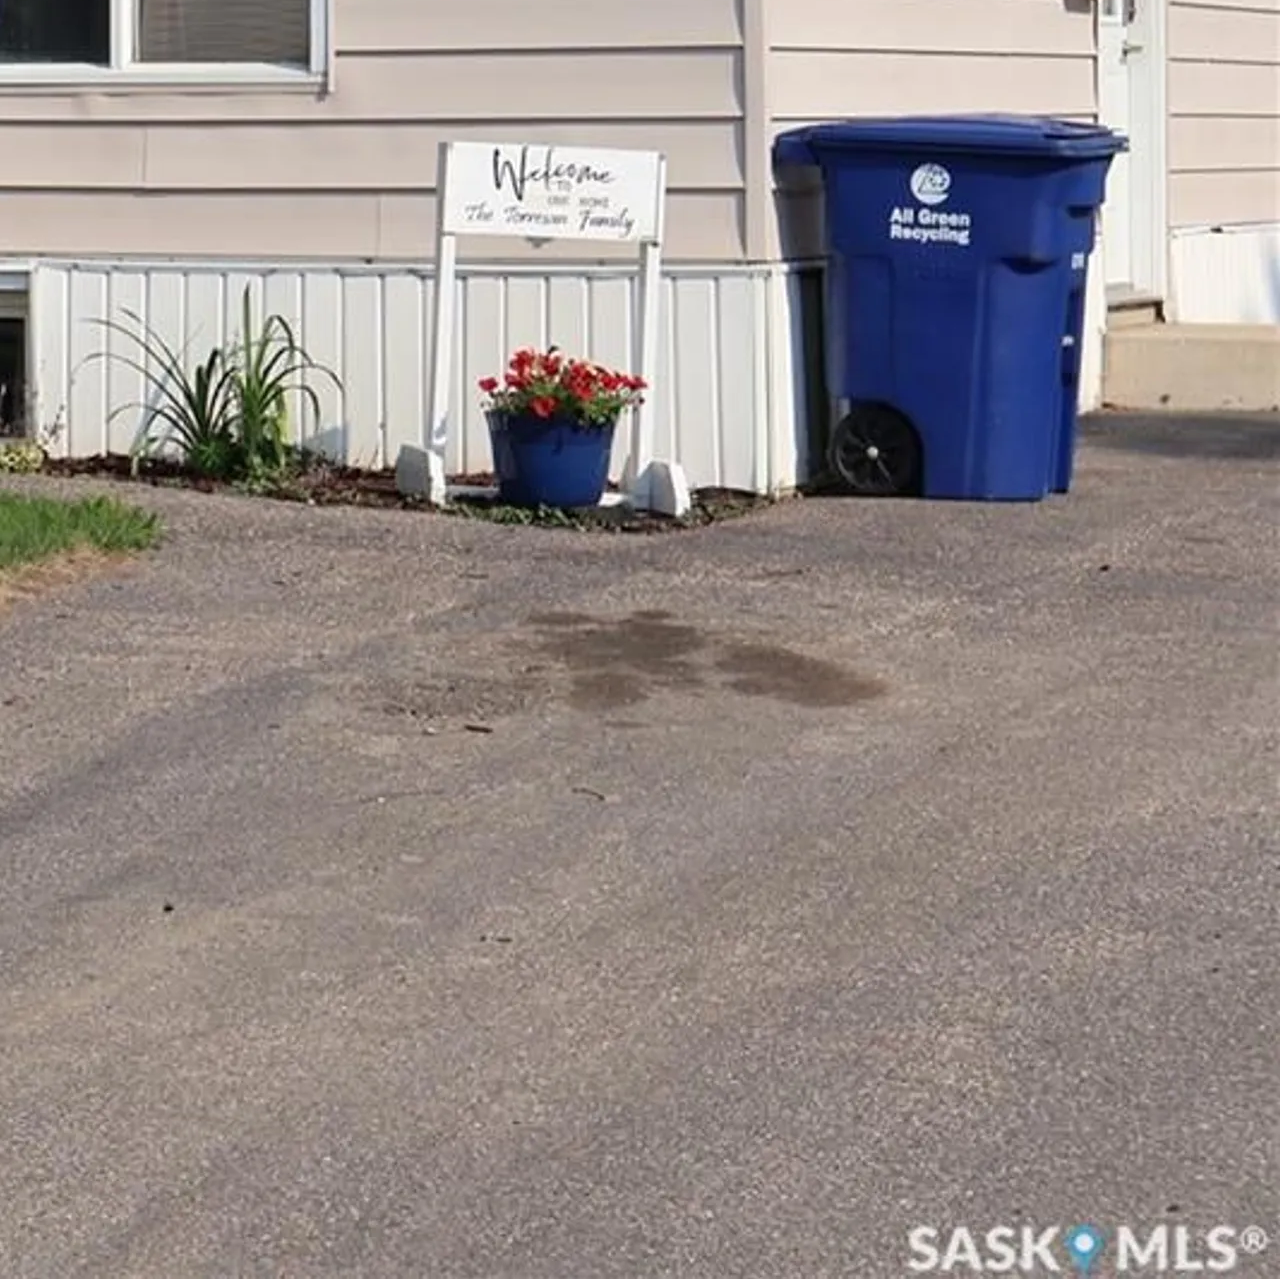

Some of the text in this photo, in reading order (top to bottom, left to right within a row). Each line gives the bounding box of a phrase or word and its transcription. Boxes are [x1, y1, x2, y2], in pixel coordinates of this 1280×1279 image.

[492, 145, 617, 201] Welcome
[465, 201, 493, 221] The
[579, 208, 636, 238] Family
[890, 207, 971, 228] All Green
[890, 223, 971, 246] Recycling
